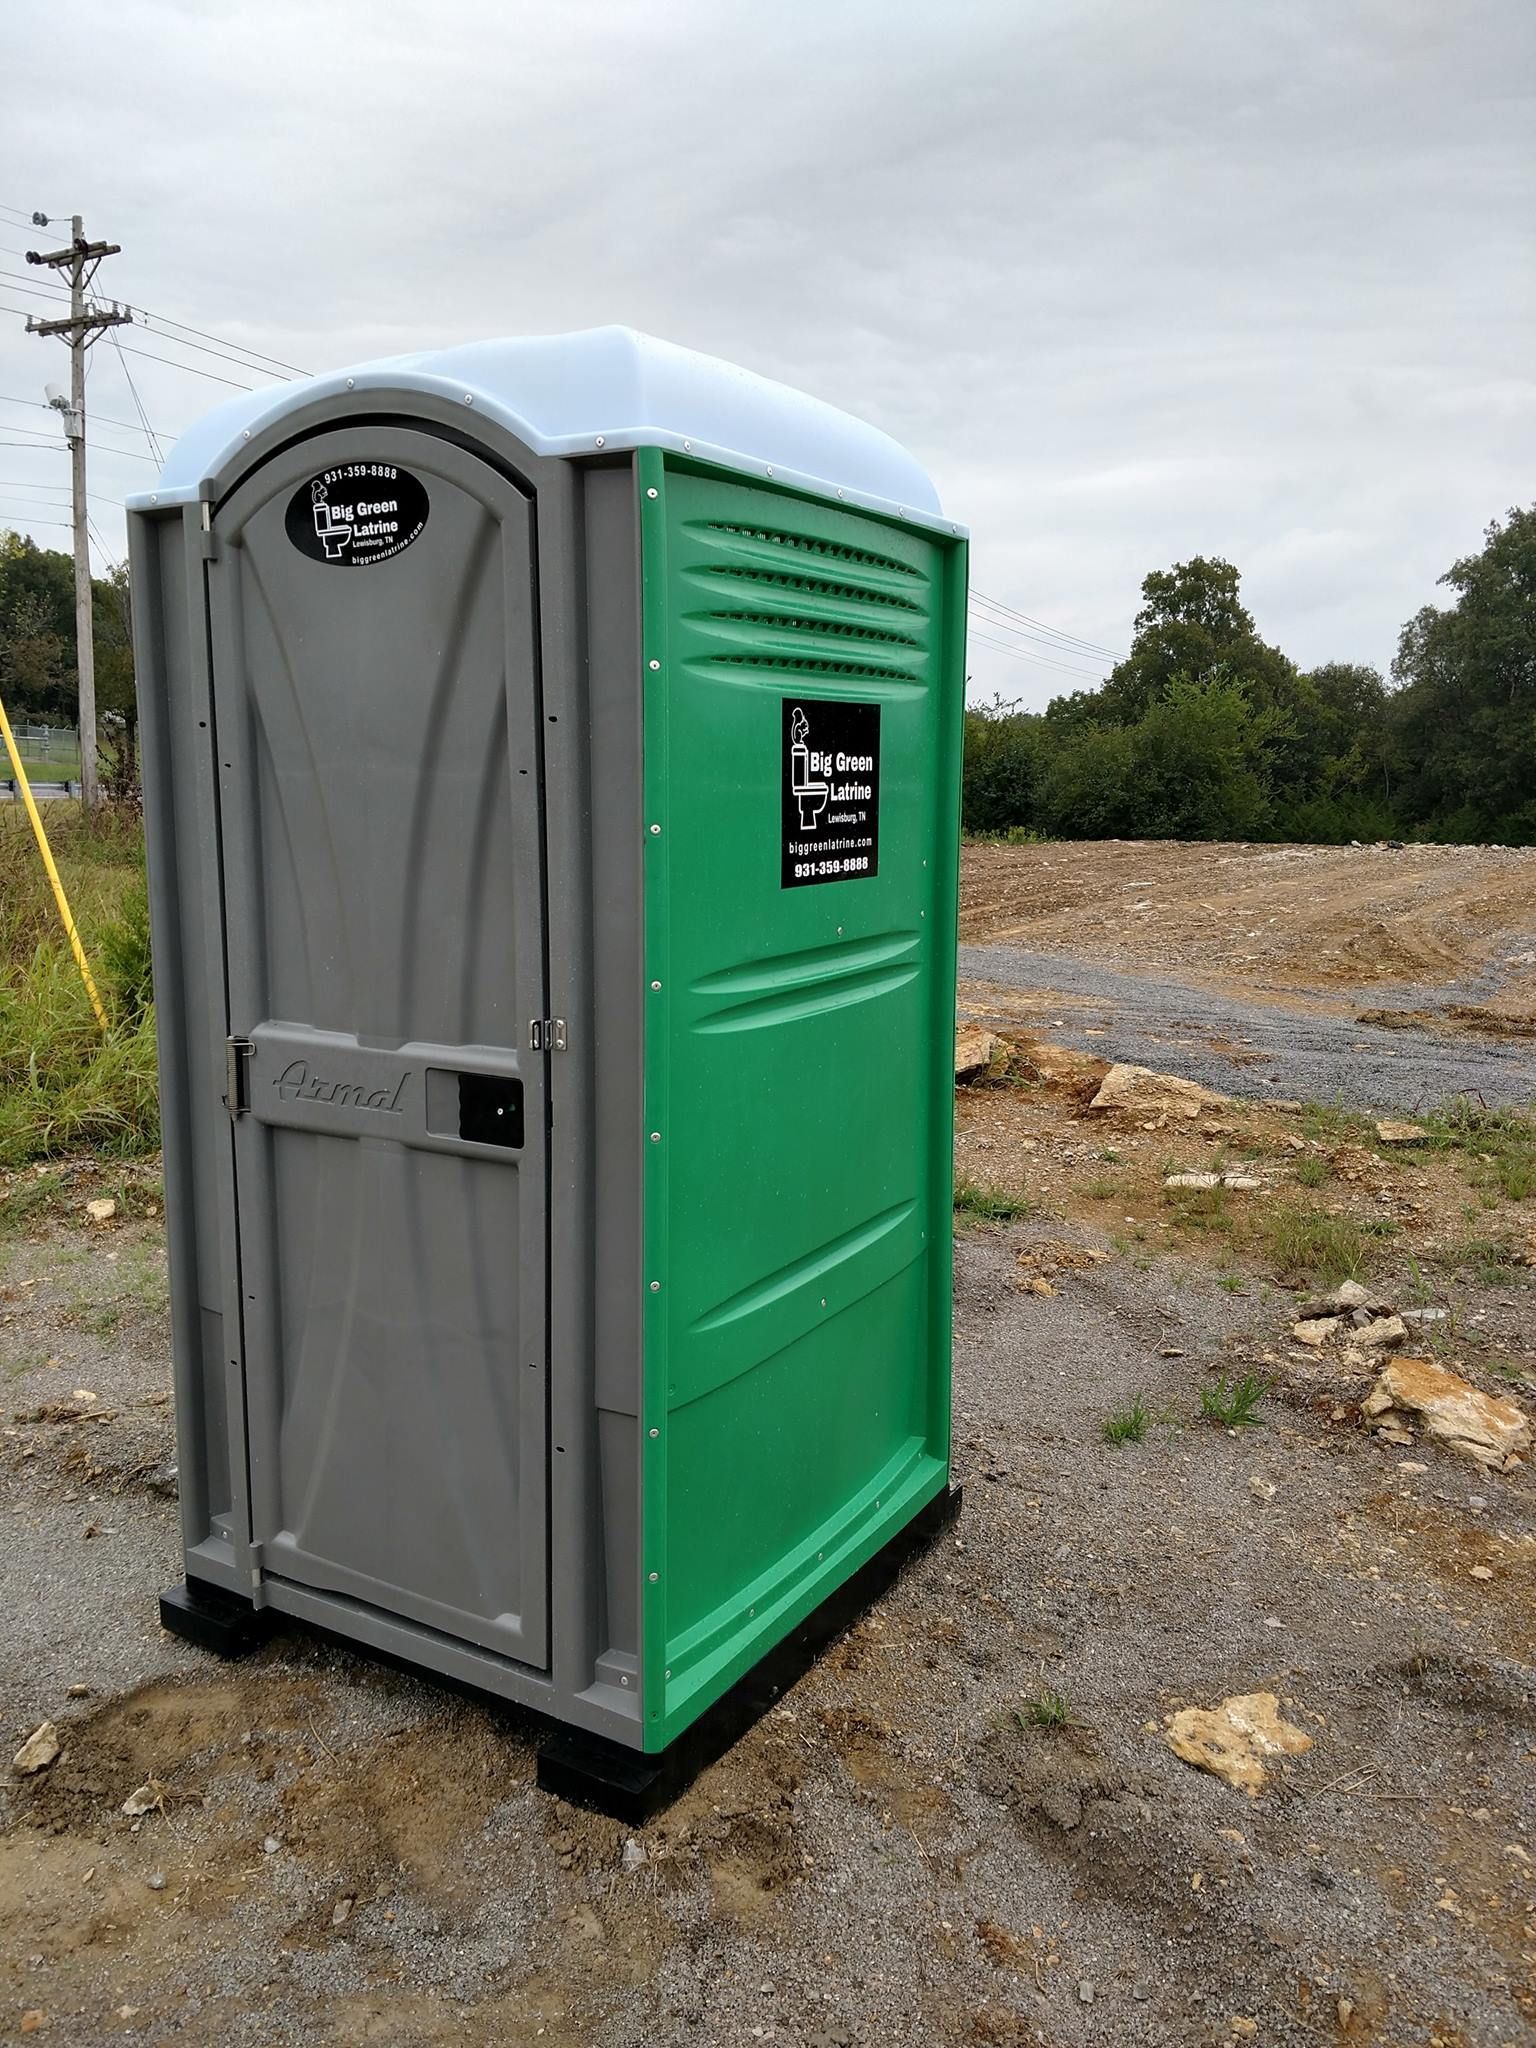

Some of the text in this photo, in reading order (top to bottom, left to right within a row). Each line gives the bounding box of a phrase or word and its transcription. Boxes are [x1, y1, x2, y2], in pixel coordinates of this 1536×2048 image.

[324, 464, 397, 484] 931-359-8888
[331, 500, 398, 522] Big Green
[353, 520, 399, 537] Latrine
[352, 536, 394, 548] Lewisburg, TN
[352, 521, 424, 565] biggreenlatrine.com
[810, 751, 873, 777] Big Green
[830, 781, 872, 801] Latrine
[828, 811, 866, 824] Lewisburg, TN
[788, 837, 873, 856] biggreenlatrine.com
[794, 856, 869, 878] 931-359-8888
[272, 1060, 412, 1114] Armal
